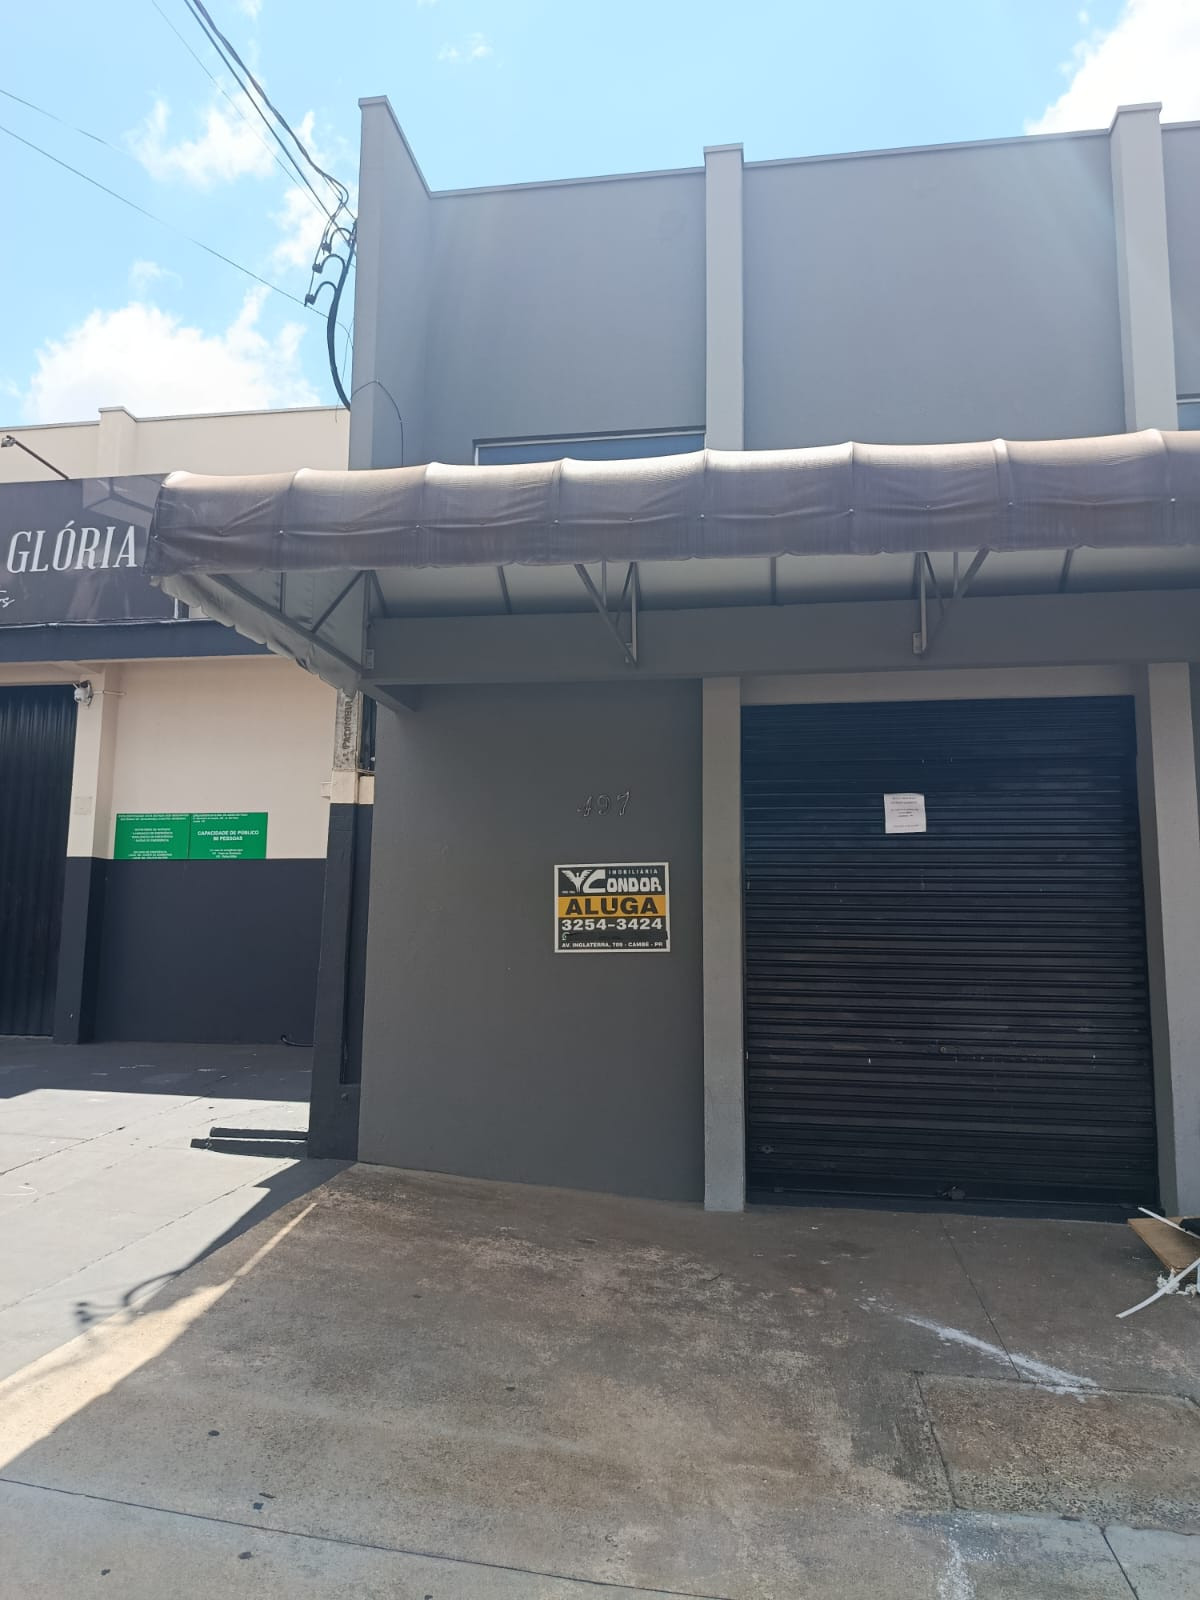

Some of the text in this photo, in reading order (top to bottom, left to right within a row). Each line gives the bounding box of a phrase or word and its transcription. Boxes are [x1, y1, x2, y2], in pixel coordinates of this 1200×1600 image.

[6, 520, 138, 574] GLÓRIA
[582, 868, 662, 894] CONDOR
[565, 897, 659, 915] ALUGA
[561, 917, 663, 931] 3254-3424
